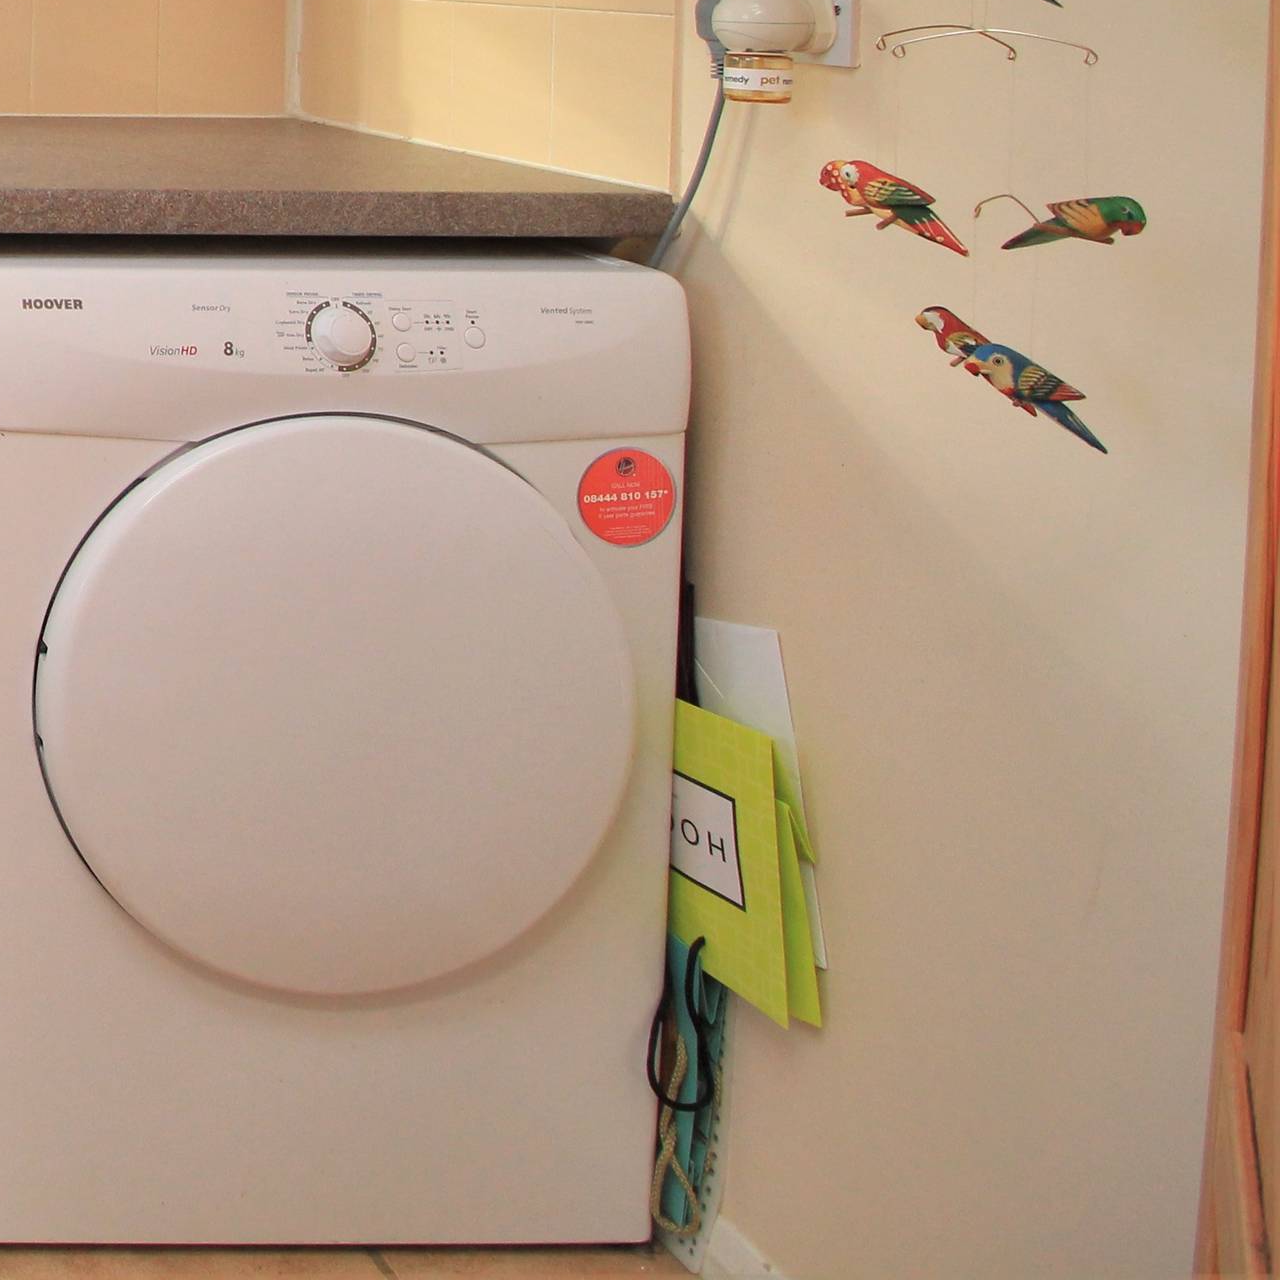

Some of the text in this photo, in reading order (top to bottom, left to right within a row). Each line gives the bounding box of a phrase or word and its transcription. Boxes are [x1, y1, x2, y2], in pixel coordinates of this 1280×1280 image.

[724, 76, 749, 85] emedy
[760, 76, 780, 86] pet
[22, 298, 83, 310] HOOVER
[583, 494, 618, 504] 08444
[621, 492, 641, 501] 810
